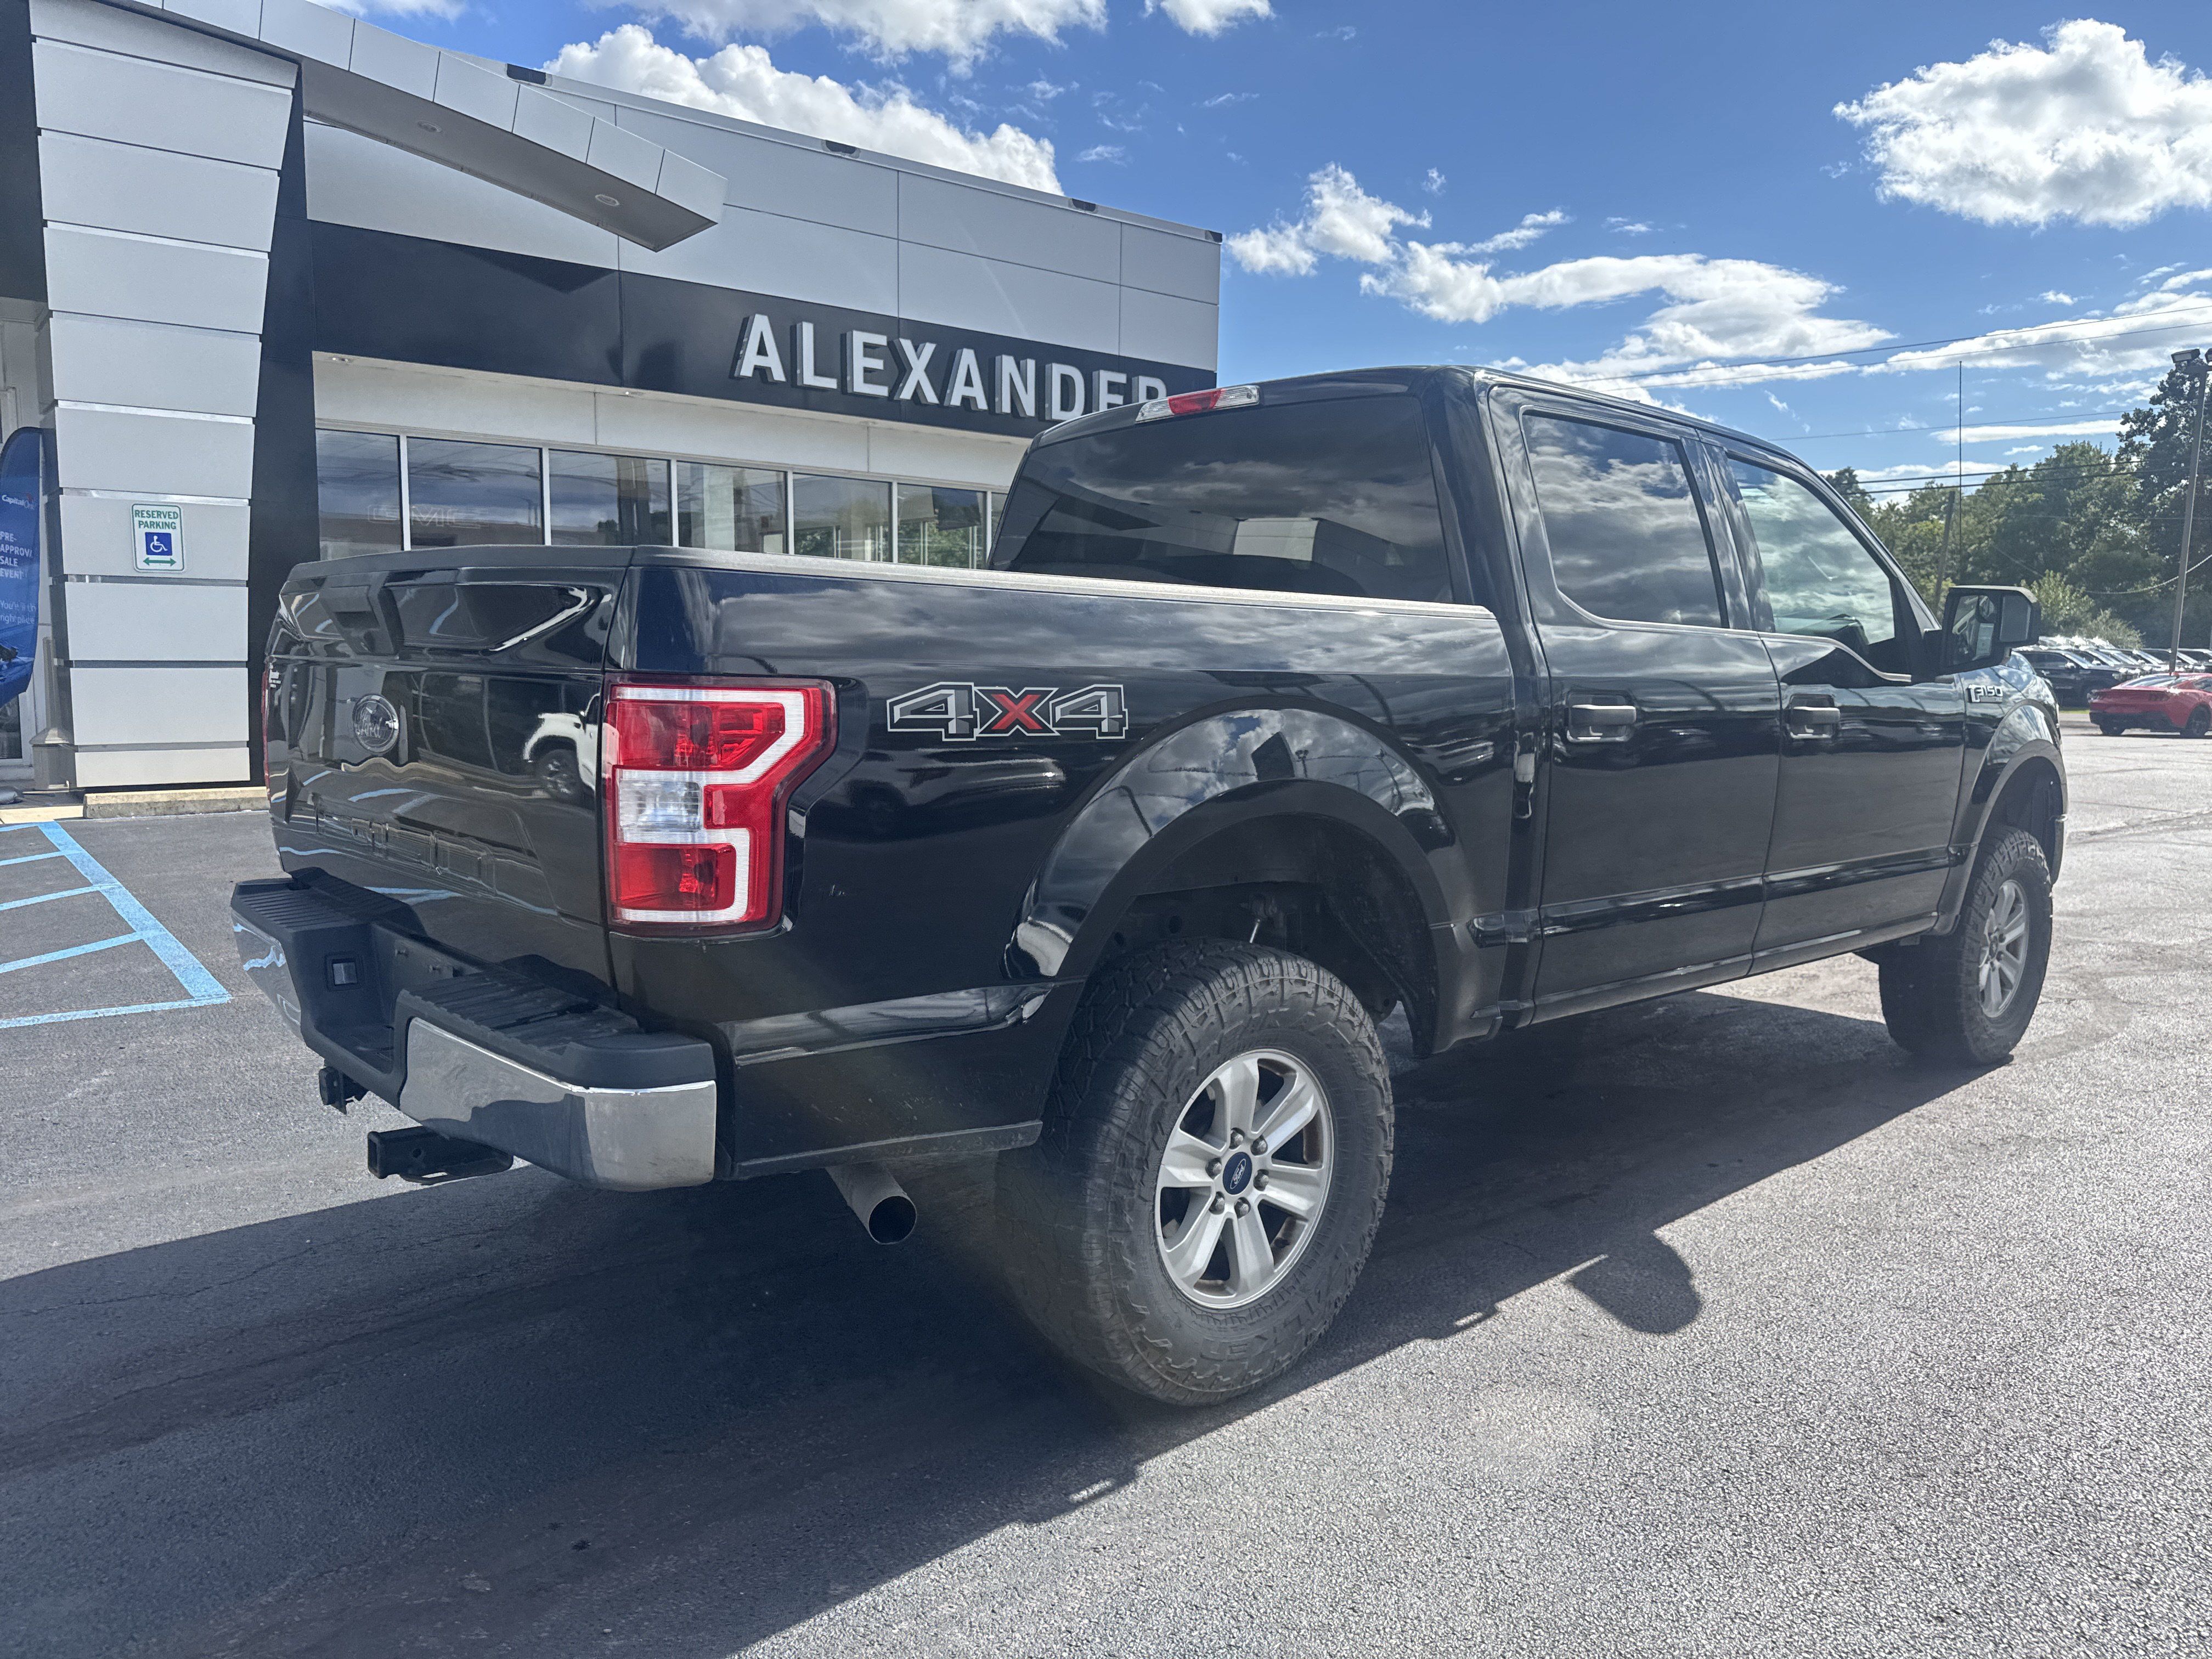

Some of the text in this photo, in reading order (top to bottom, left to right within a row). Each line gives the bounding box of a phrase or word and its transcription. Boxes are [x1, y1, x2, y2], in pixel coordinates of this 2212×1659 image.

[134, 510, 179, 519] RESERVED
[138, 520, 177, 529] PARKING
[0, 556, 18, 567] SALE
